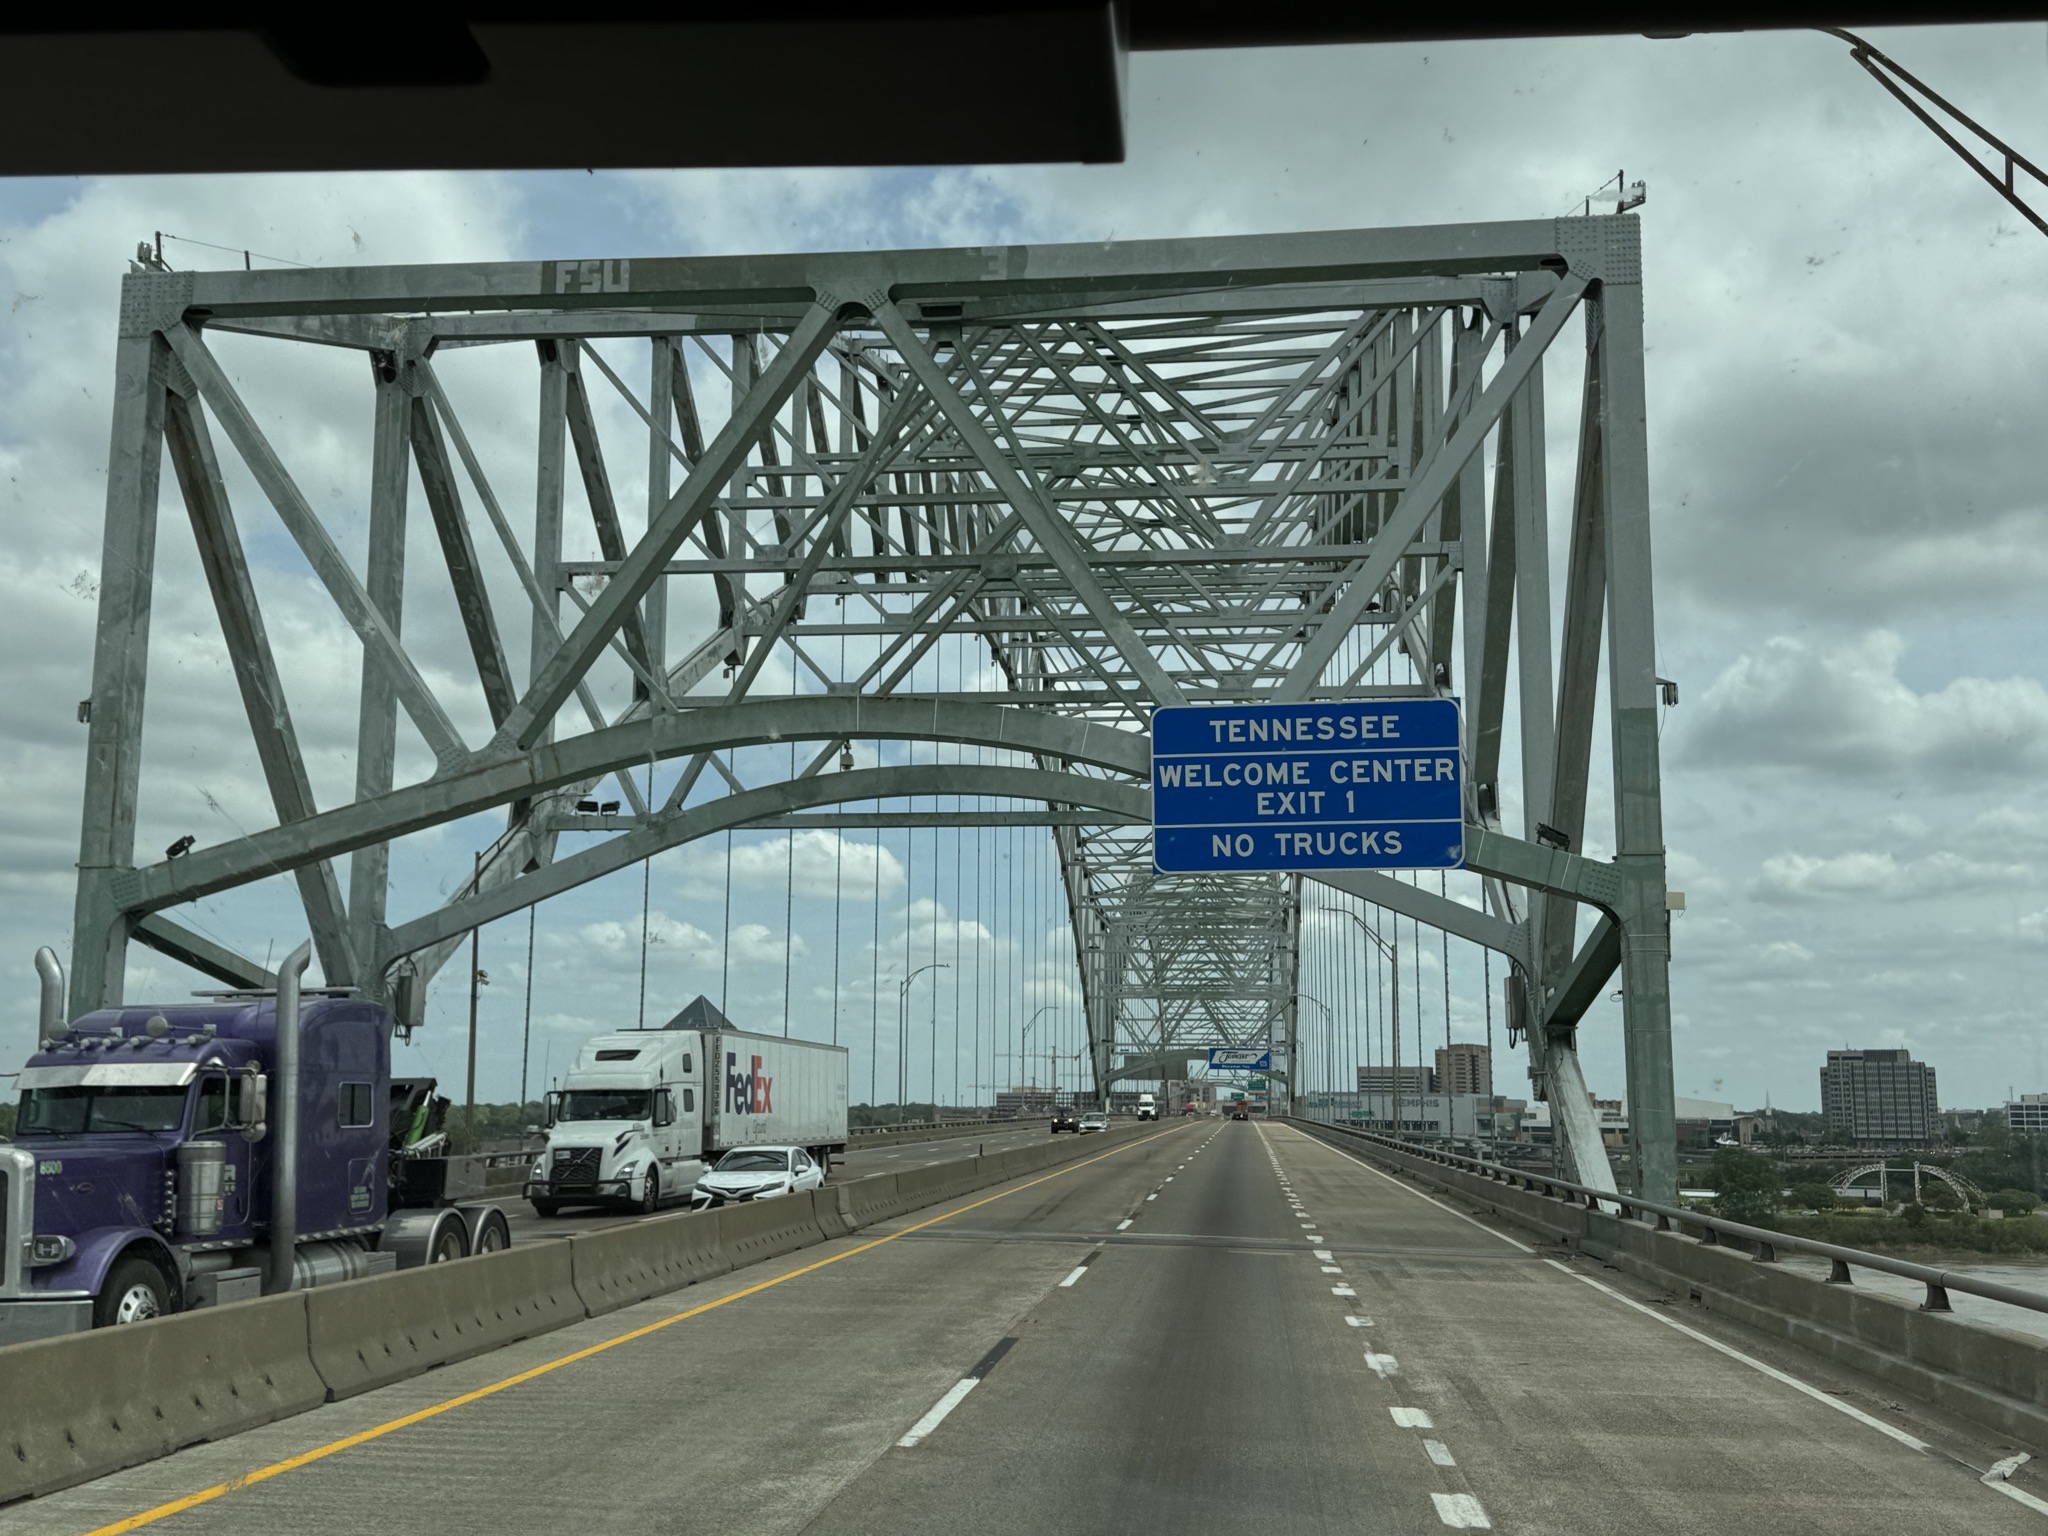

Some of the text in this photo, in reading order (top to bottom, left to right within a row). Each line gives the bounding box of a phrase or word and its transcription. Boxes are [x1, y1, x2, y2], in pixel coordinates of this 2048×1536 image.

[556, 260, 630, 294] FSU
[1209, 715, 1400, 742] TENNESSEE
[1159, 758, 1455, 787] WELCOME CENTER
[1257, 790, 1355, 815] EXIT 1
[1212, 831, 1402, 857] NO TRUCKS
[725, 1052, 773, 1115] FedEx
